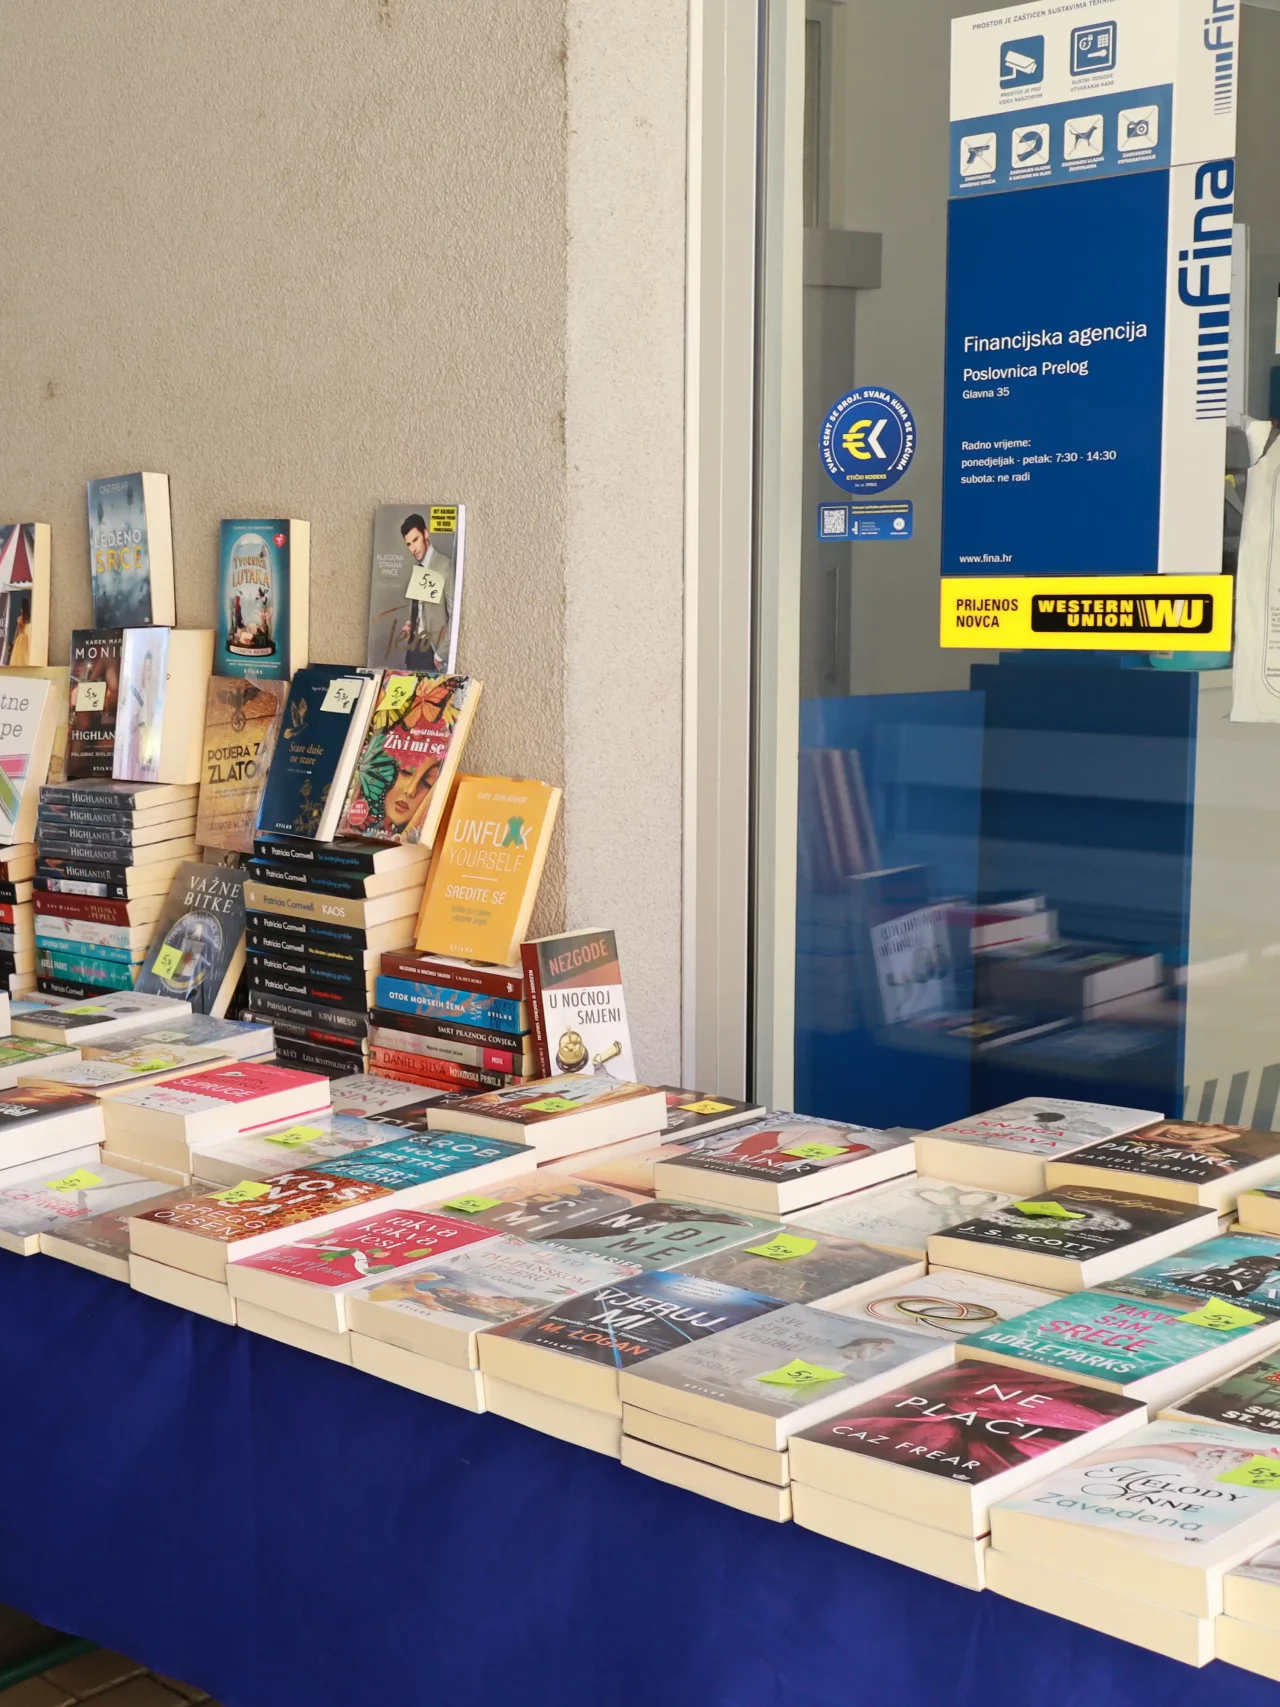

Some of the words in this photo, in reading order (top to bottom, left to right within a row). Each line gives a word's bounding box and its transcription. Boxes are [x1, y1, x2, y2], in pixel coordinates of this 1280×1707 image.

[972, 19, 1003, 31] PROSTOR
[1004, 16, 1012, 24] JE
[1048, 1, 1088, 16] SUSTAVIMA
[1177, 158, 1235, 308] fina
[964, 329, 1062, 353] Financijska
[1068, 321, 1147, 346] agencija
[963, 364, 1037, 382] Poslovnica
[1042, 360, 1089, 376] Prelog
[863, 390, 891, 402] SVAKA
[962, 389, 994, 400] Glavna
[996, 387, 1010, 397] 35
[962, 440, 992, 450] Radno
[994, 438, 1031, 450] vrijeme:
[961, 456, 1015, 469] ponedjeljak
[1022, 454, 1052, 466] petak:
[1056, 452, 1078, 463] 7:30
[1086, 450, 1117, 462] 14:30
[960, 473, 995, 484] subota:
[997, 473, 1010, 482] ne
[1012, 472, 1031, 482] radi
[94, 529, 141, 549] LEDENO
[95, 545, 144, 573] SRCE
[233, 556, 267, 570] TVORNICA
[376, 553, 404, 562] NJEGOVA
[959, 554, 1013, 564] www.fina.hr
[232, 568, 270, 588] LUTAKA
[956, 599, 1018, 612] PRIJENOS
[1038, 600, 1133, 613] WESTERN
[956, 615, 1000, 629] NOVCA
[1067, 613, 1133, 627] UNION
[384, 731, 412, 750] Živi
[413, 738, 428, 752] mi
[428, 742, 446, 755] se
[208, 747, 251, 762] POTJERA
[71, 792, 119, 805] HIGHLANDER
[70, 811, 118, 823] HIGHLANDER
[69, 828, 116, 841] HIGHLANDER
[70, 847, 119, 860] HIGHLANDER
[272, 847, 290, 857] Patricia
[291, 850, 314, 860] Cornwell
[448, 847, 524, 873] YOURSELF
[66, 866, 112, 879] HIGHLANDER
[266, 869, 284, 879] Patricia
[285, 872, 307, 883] Cornwell
[190, 875, 241, 898] VAŽNE
[445, 884, 490, 904] SREDITE
[491, 890, 506, 905] SE
[184, 893, 233, 914] BITKE
[264, 895, 286, 907] Patricia
[286, 899, 314, 912] Cornwell
[322, 905, 345, 917] KAOS
[263, 919, 282, 929] Patricia
[283, 922, 307, 933] Cornwell
[263, 938, 282, 948] Patricia
[282, 941, 305, 953] Cornwell
[264, 959, 282, 970] Patricia
[283, 962, 306, 974] Cornwell
[549, 939, 609, 977] NEZGODE
[265, 979, 283, 990] Patricia
[284, 983, 307, 995] Cornwell
[528, 969, 536, 995] NEZGODE
[388, 991, 409, 1002] OTOK
[410, 995, 445, 1010] MORSKIH
[446, 1000, 466, 1013] ŽENA
[487, 1012, 513, 1021] STILUS
[549, 994, 558, 1009] U
[562, 988, 611, 1008] NOĆNOJ
[267, 1001, 287, 1012] Patricia
[288, 1004, 312, 1018] Cornwell
[319, 1012, 329, 1022] KRV
[336, 1016, 356, 1027] MESO
[577, 1008, 621, 1025] SMJENI
[438, 1025, 455, 1036] SMRT
[456, 1028, 487, 1042] PRAZNOG
[488, 1034, 518, 1048] ČOVJEKA
[383, 1053, 418, 1069] DANIEL
[420, 1061, 446, 1076] SILVA
[173, 1078, 255, 1098] SUPRUGE
[940, 1127, 1058, 1148] DOJMOVA
[976, 1120, 1066, 1138] KNJIGA
[397, 1146, 460, 1163] MOJE
[410, 1136, 500, 1158] GROB
[1097, 1141, 1238, 1168] PARIŽANKE
[366, 1150, 451, 1172] SESTRE
[1075, 1152, 1135, 1165] MARIUS
[1140, 1160, 1207, 1177] GABRIEL
[154, 1210, 241, 1238] OLSEN
[175, 1203, 267, 1229] GREGG
[491, 1210, 560, 1233] MI
[605, 1236, 687, 1263] ME
[984, 1228, 1003, 1237] S.
[1012, 1233, 1095, 1252] SCOTT
[593, 1289, 727, 1328] VJERUJ
[589, 1309, 656, 1331] MI
[773, 1315, 808, 1328] SVE
[1094, 1315, 1153, 1333] SAM
[535, 1338, 574, 1350] STILUS
[538, 1322, 561, 1334] M.
[567, 1329, 651, 1356] LOGAN
[789, 1331, 832, 1345] SMO
[1039, 1319, 1158, 1353] SREĆE
[980, 1332, 1057, 1354] ADELE
[1053, 1346, 1137, 1373] PARKS
[975, 1383, 1053, 1410] NE
[895, 1396, 1043, 1440] PLAČI
[1222, 1410, 1255, 1423] ST.
[832, 1425, 884, 1446] CAZ
[896, 1441, 981, 1471] FREAR
[1084, 1465, 1249, 1503] MELODY
[1081, 1483, 1205, 1515] ANNE
[1033, 1492, 1205, 1532] Zavedena
